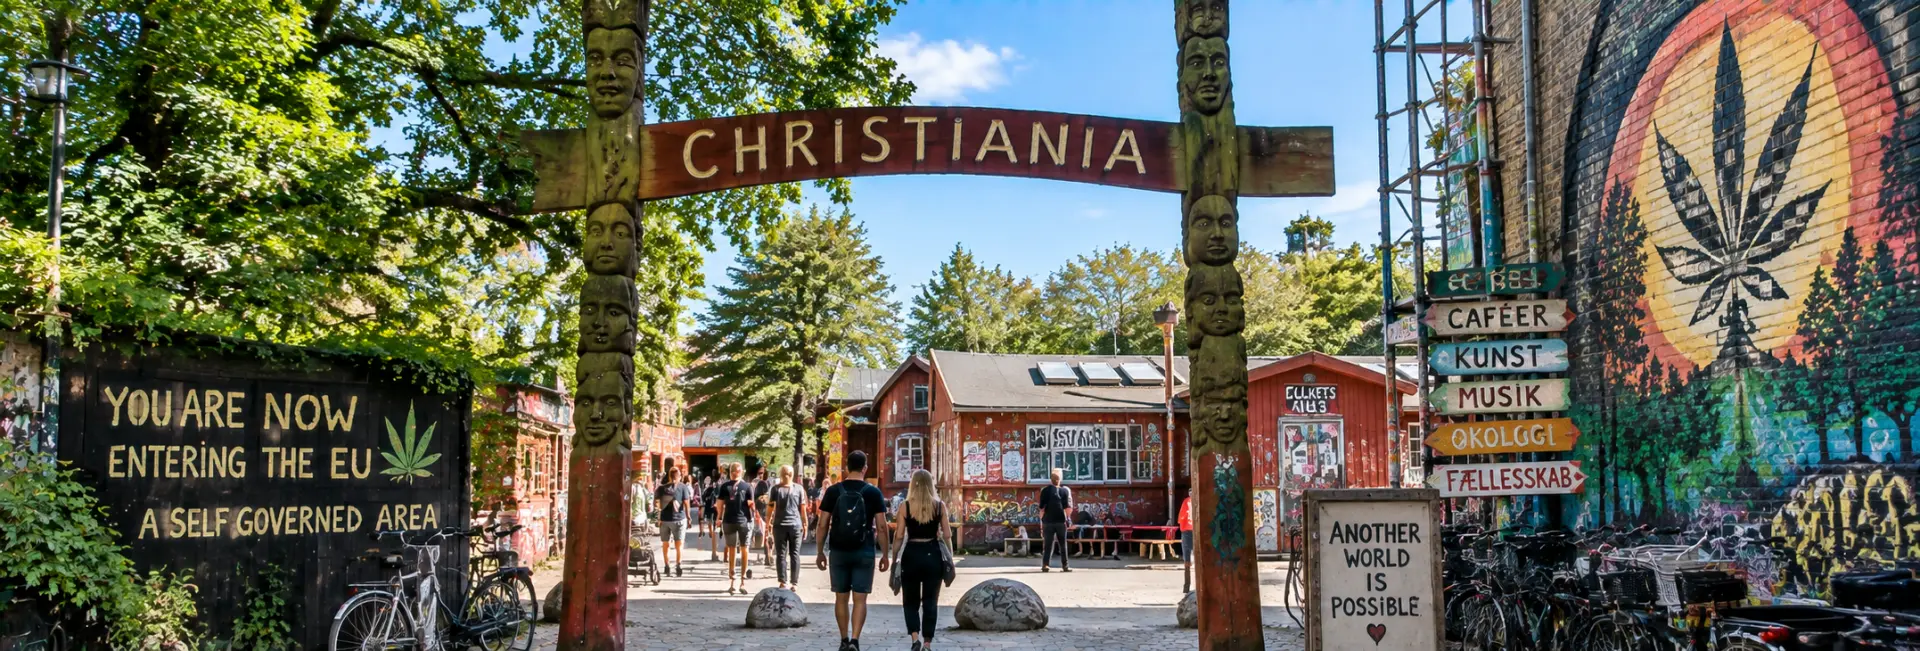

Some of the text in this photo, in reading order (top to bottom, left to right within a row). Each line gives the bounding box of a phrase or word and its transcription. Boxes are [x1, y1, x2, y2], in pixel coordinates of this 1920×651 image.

[683, 116, 1146, 178] CHRISTIANIA
[1455, 345, 1542, 369] KUNST
[104, 386, 358, 431] YOU ARE NOW
[1459, 384, 1542, 409] MUSIK
[109, 441, 371, 479] ENTERING THE EU
[1447, 466, 1572, 492] FÆLLESSKAB
[138, 504, 438, 539] A SELF GOVERNED AREA
[1329, 521, 1421, 544] ANOTHER
[1344, 548, 1410, 568] WORLD
[1367, 573, 1387, 591] IS
[1331, 596, 1420, 618] POSSIBLE
